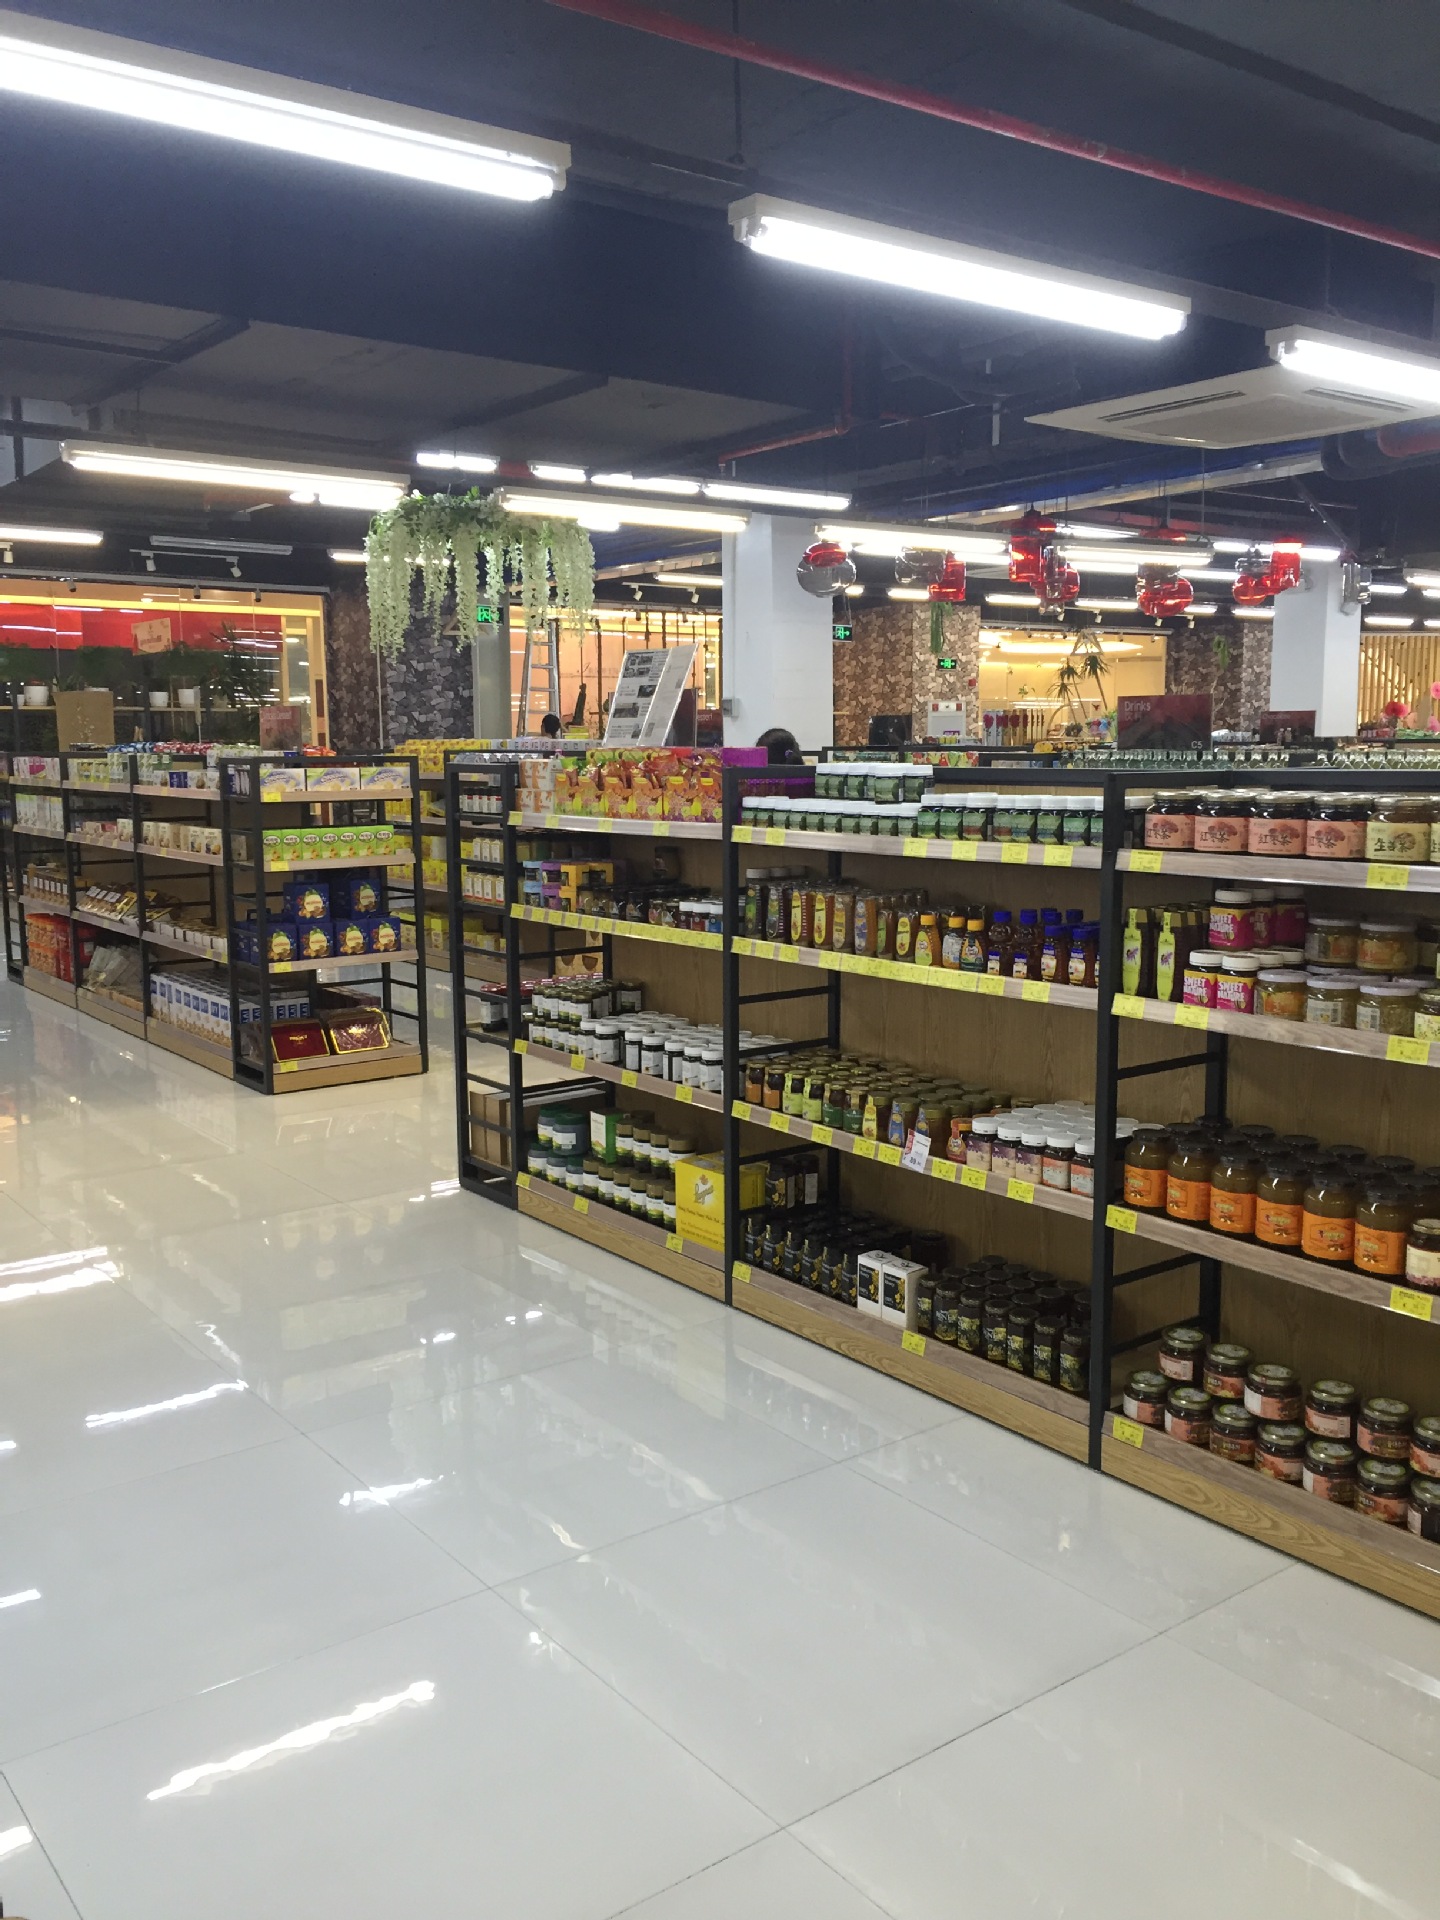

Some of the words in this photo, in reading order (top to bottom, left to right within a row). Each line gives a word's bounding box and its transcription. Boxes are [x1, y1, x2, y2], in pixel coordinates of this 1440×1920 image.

[1124, 701, 1151, 711] Drinks
[1191, 740, 1203, 749] C5
[1210, 914, 1233, 924] SWEET
[1209, 922, 1234, 933] NATURE
[1184, 977, 1206, 988] SWEET
[1218, 981, 1244, 992] SWEET
[1184, 986, 1208, 997] NATURE
[1217, 989, 1245, 1001] NATURE
